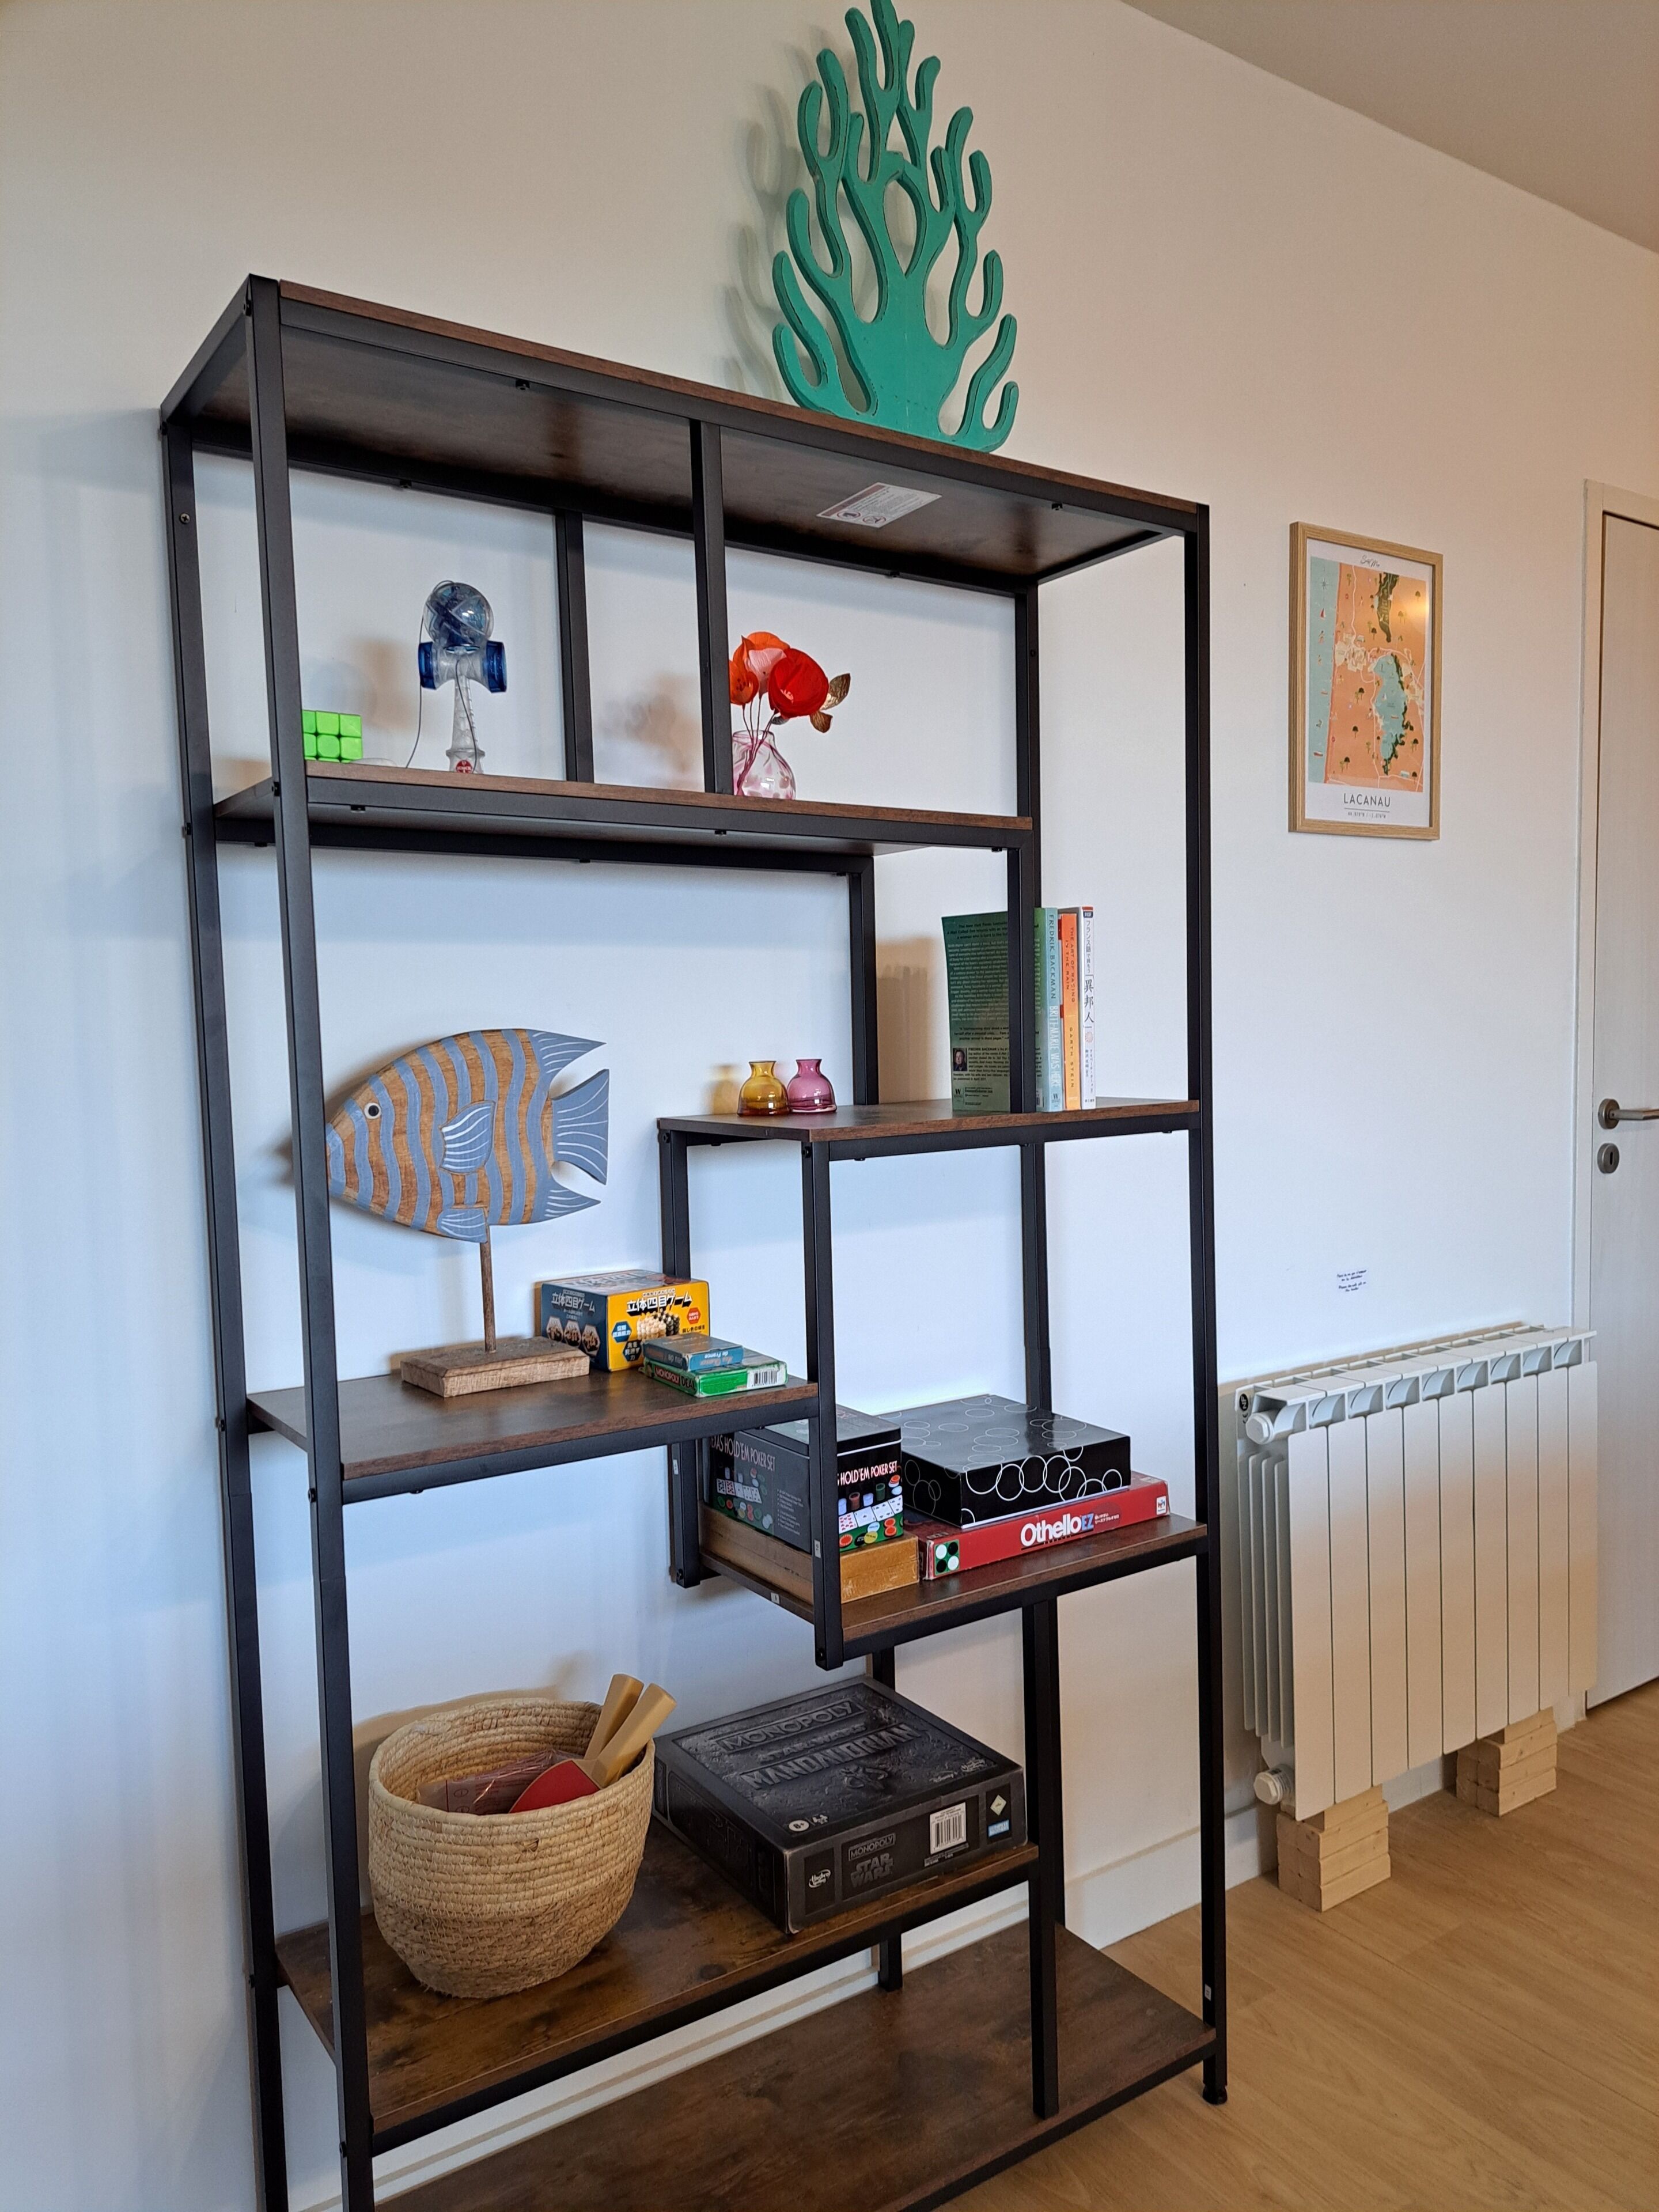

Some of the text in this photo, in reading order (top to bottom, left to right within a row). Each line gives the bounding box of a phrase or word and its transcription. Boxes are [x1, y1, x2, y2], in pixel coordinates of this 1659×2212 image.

[1344, 793, 1390, 807] LACANAU
[1071, 960, 1074, 969] OF
[1050, 1005, 1059, 1050] BRITT-MARIE
[1051, 1053, 1060, 1069] WAS
[1051, 1073, 1060, 1088] HERE
[551, 1292, 595, 1313] 立体四目ゲーム
[626, 1291, 692, 1312] 立体四目ゲーム
[656, 1366, 696, 1391] MONOPOLY DEAL
[1241, 1396, 1247, 1409] NF
[725, 1437, 749, 1463] HOLD'EM
[751, 1447, 767, 1468] POKER
[767, 1454, 775, 1472] SET
[840, 1467, 870, 1486] HOLD'EM
[870, 1463, 888, 1478] POKER
[889, 1460, 897, 1474] SET
[1020, 1513, 1082, 1547] Othello
[1081, 1513, 1094, 1531] EZ
[722, 1702, 853, 1750] MONOPOLY
[757, 1723, 866, 1763] STAR WARS
[741, 1724, 922, 1790] MANDALORIAN
[851, 1835, 893, 1858] MONOPOLY
[856, 1853, 893, 1873] STAR
[850, 1865, 893, 1888] WARS
